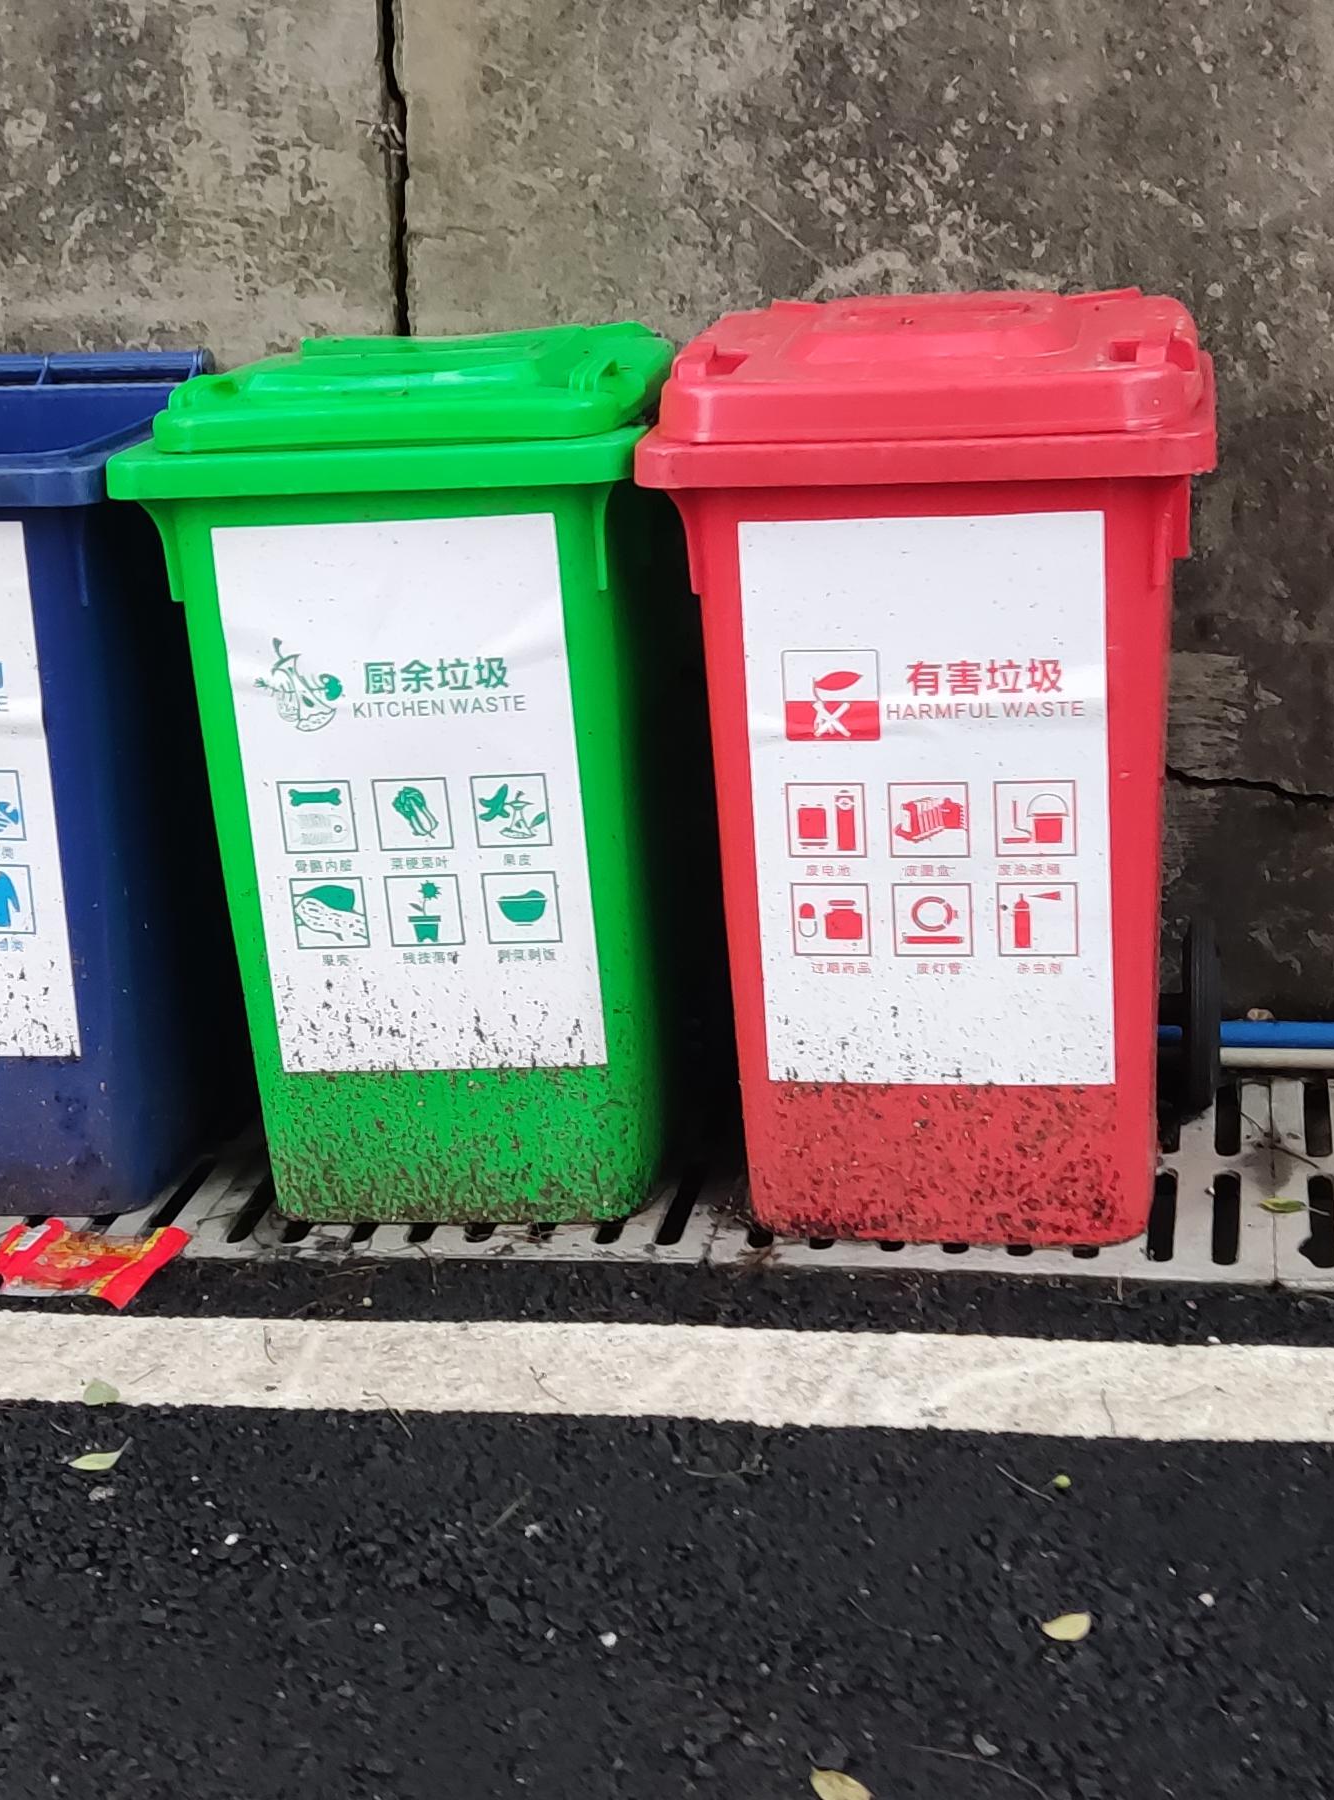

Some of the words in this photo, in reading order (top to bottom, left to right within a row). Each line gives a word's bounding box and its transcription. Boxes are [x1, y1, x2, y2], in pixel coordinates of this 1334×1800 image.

[364, 656, 509, 693] 厨余垃圾
[906, 660, 1063, 696] 有害垃圾
[353, 698, 456, 719] KITCHEN
[456, 695, 527, 714] WASTE
[886, 701, 998, 720] HARMFUL
[1004, 700, 1085, 718] WASTE
[503, 854, 531, 866] 果皮
[805, 865, 851, 876] 废电池
